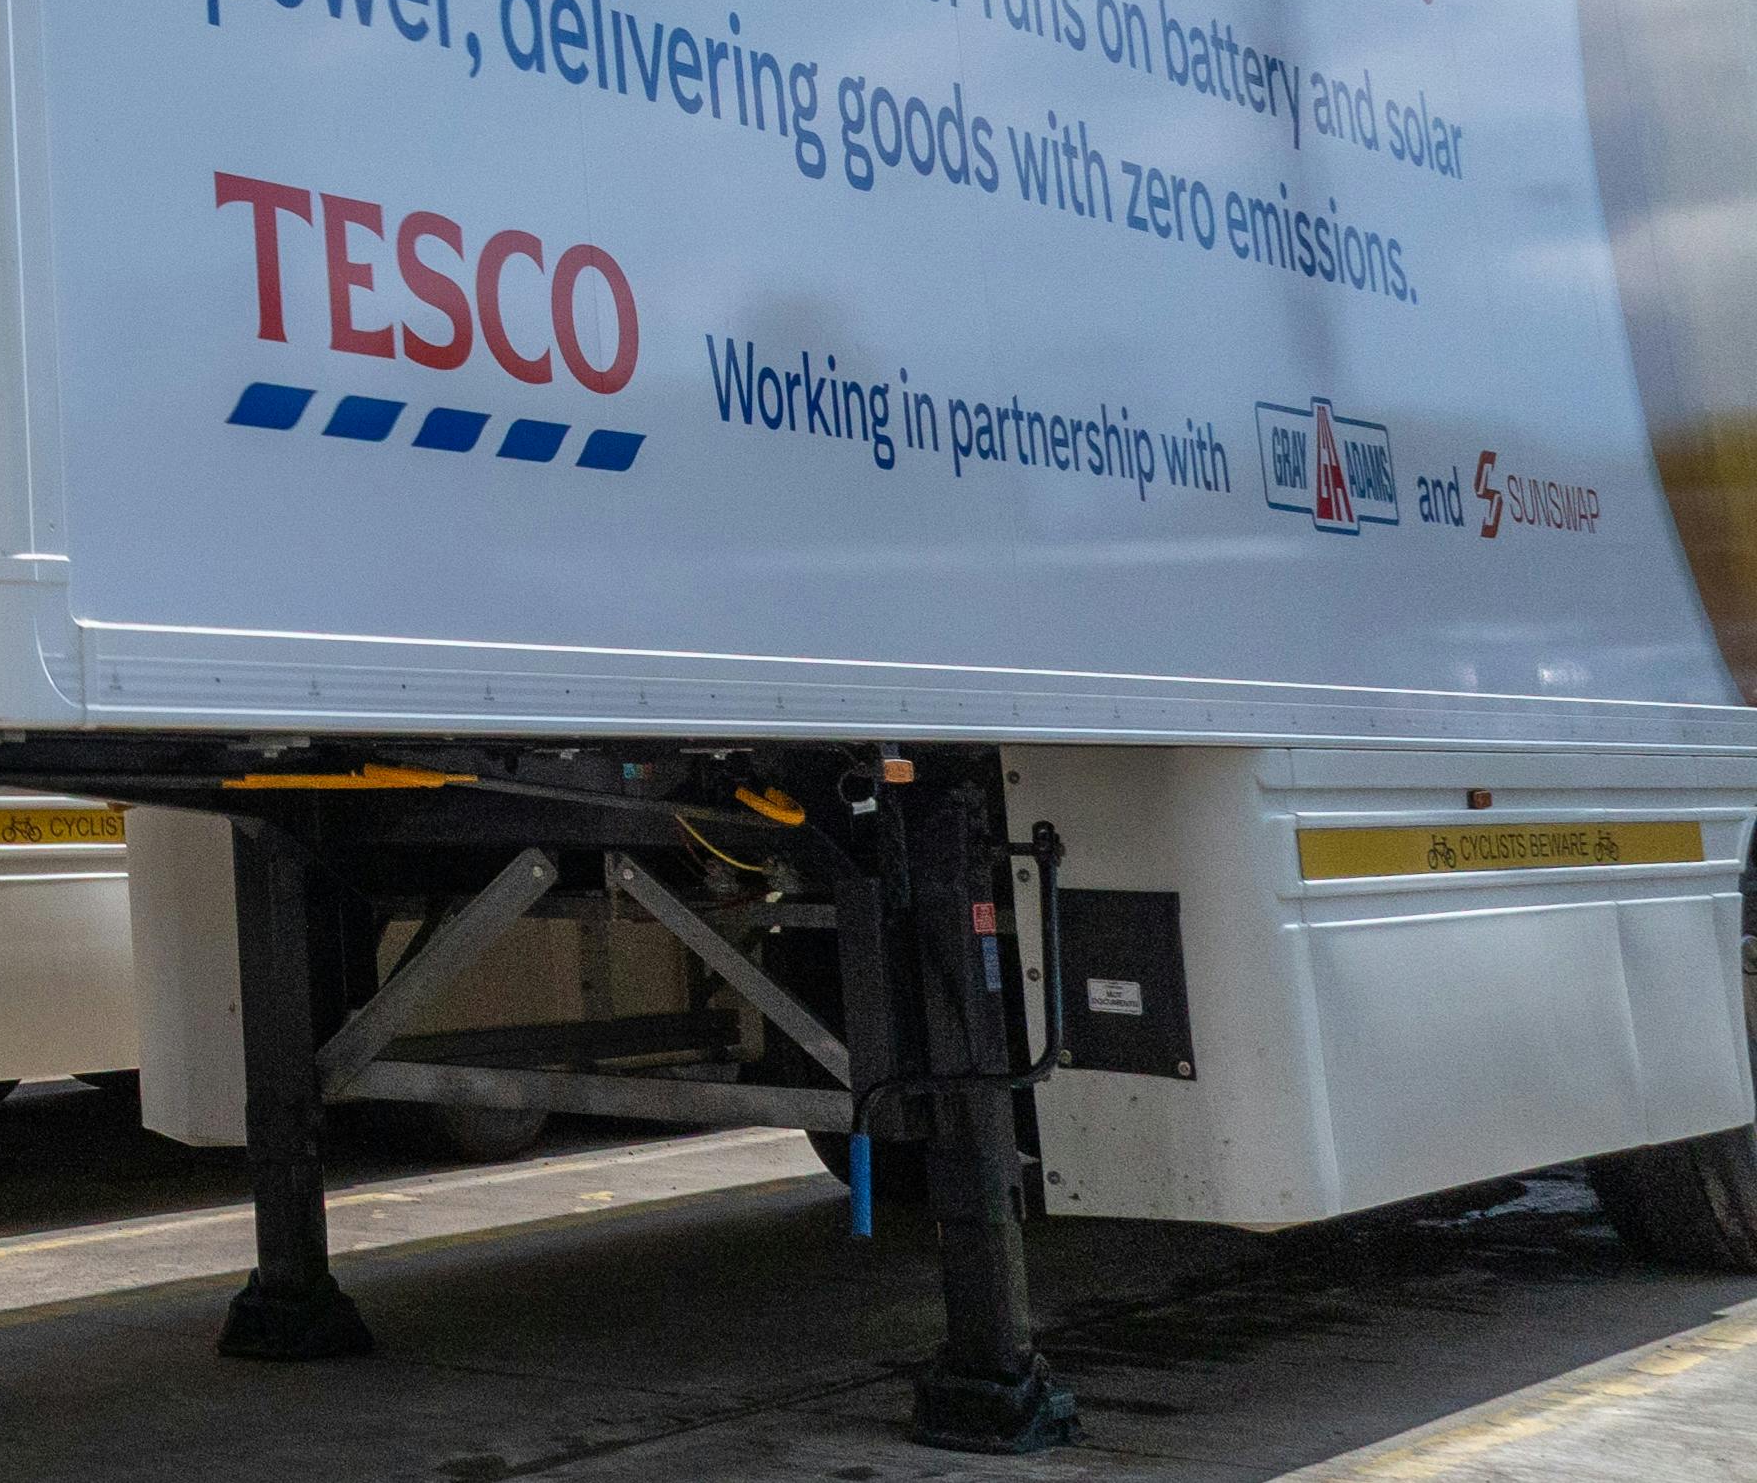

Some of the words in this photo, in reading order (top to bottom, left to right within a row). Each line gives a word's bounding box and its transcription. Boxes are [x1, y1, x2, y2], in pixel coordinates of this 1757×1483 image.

[838, 82, 999, 192] goods
[1007, 110, 1113, 223] with
[1122, 160, 1215, 250] zero
[1226, 182, 1418, 305] emissions.
[1310, 69, 1380, 152] and
[1386, 90, 1464, 180] solar
[214, 171, 639, 394] TESCO
[705, 334, 896, 470] Working
[900, 367, 939, 452] in
[948, 395, 1155, 502] partnership
[1160, 418, 1231, 494] with
[1271, 426, 1307, 490] GRAY
[1344, 440, 1395, 503] ADAMS
[1417, 465, 1465, 527] and
[1507, 474, 1600, 533] SUNSWAP
[50, 815, 126, 838] CYCLIST
[1460, 834, 1526, 861] CYCLISTS
[1530, 832, 1589, 859] BEWARE
